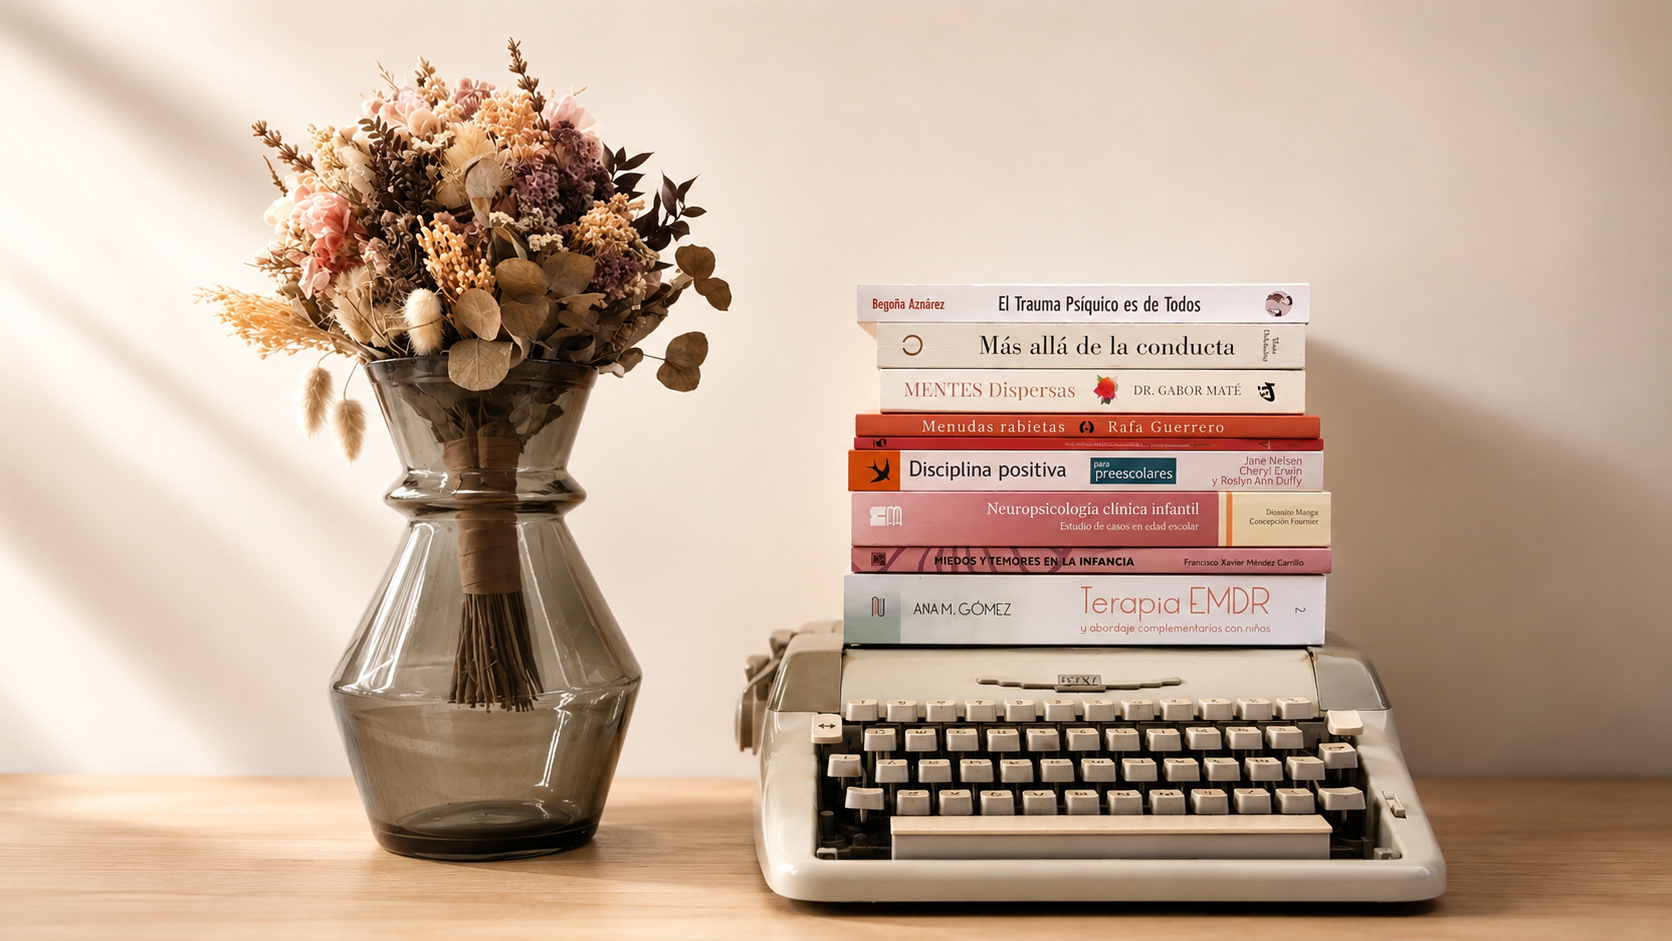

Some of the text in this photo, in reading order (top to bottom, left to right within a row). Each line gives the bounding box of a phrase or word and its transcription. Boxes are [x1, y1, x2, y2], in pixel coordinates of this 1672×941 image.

[872, 298, 945, 312] Begoña Aznárez
[998, 295, 1200, 315] El Trauma Psíquico es de Todos
[979, 335, 1235, 355] Más allá de la conducta
[904, 382, 1075, 401] MENTES Dispersas
[1134, 383, 1242, 396] DR. GABOR MATÉ
[922, 420, 1065, 432] Menudas rabietas
[1108, 421, 1224, 433] Rafa Guerrero
[1244, 456, 1302, 465] Jane Nelsen
[909, 460, 1066, 481] Disciplina positiva
[1095, 467, 1173, 482] preescolares
[1240, 466, 1302, 477] Cheryl Erwin
[1212, 476, 1302, 487] y Roslyn Ann Duffy
[987, 502, 1199, 518] Neuropsicología clínica infantil
[1060, 522, 1091, 530] Estudio
[1094, 522, 1104, 530] de
[1145, 522, 1166, 531] edad
[1168, 522, 1199, 531] escolar
[1249, 518, 1289, 526] Concepción
[935, 556, 1134, 566] MIEDOS Y TEMORES EN LA INFANCIA
[913, 600, 1012, 616] ANA M. GÓMEZ
[1081, 586, 1270, 621] Terapia EMDR
[1080, 625, 1087, 633] y
[1090, 624, 1135, 635] abordaje
[1138, 624, 1222, 635] complementarios
[1245, 623, 1271, 632] niños
